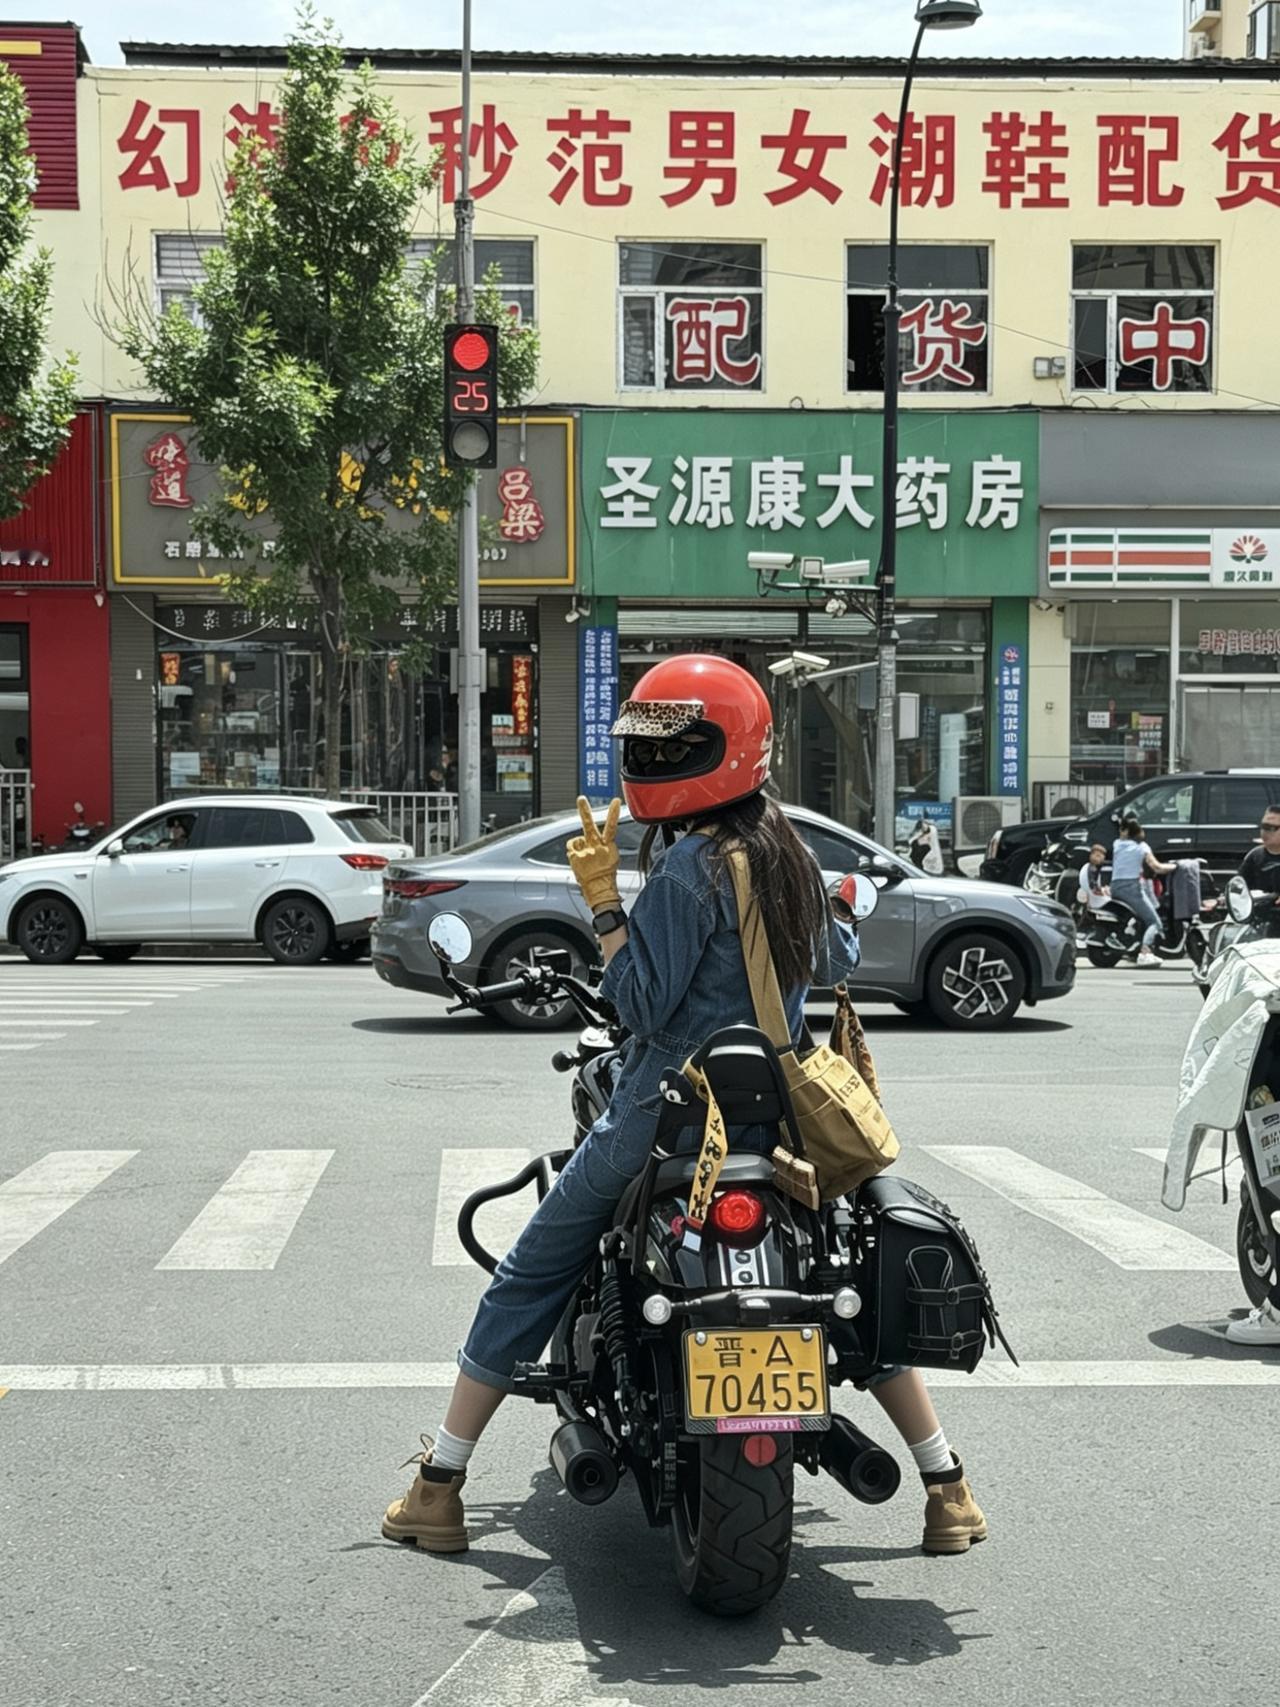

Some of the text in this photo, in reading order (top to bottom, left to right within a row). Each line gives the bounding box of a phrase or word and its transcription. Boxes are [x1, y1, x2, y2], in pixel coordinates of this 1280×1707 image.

[117, 99, 1280, 211] 幻秒范男女潮鞋配货
[667, 297, 1209, 390] 配 货 中
[454, 381, 489, 411] 25
[501, 470, 540, 536] 吕梁
[599, 454, 1025, 531] 圣源康大药房
[696, 1371, 818, 1414] 70455
